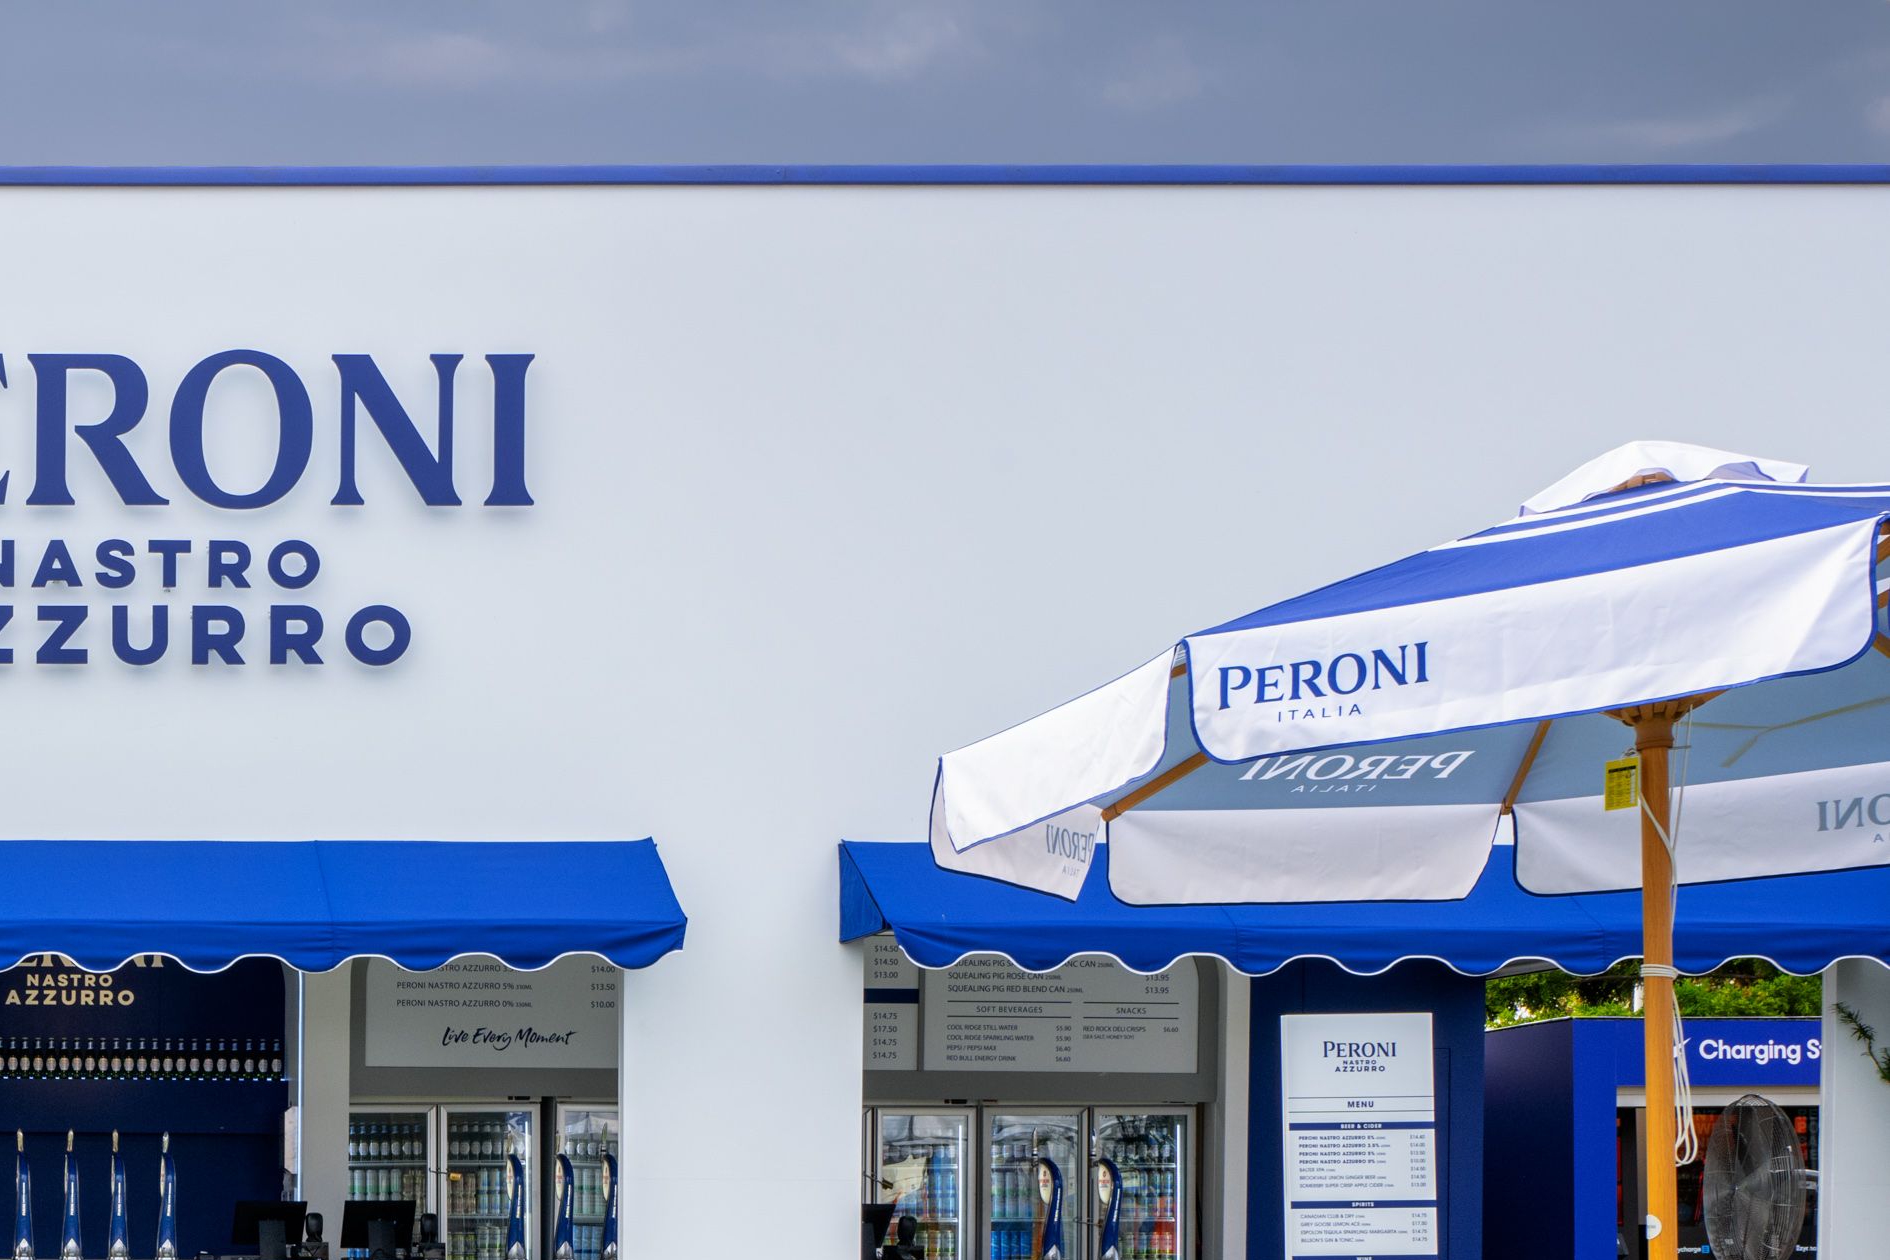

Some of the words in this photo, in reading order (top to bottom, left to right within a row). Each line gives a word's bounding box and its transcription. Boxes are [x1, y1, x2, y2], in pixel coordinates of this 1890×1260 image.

[1218, 641, 1429, 711] PERONI
[1278, 703, 1362, 722] ITALIA
[874, 958, 899, 966] $14.50
[1080, 960, 1096, 968] CAN
[591, 966, 616, 974] $14.00
[948, 972, 991, 980] SQUEALING
[993, 972, 1005, 980] PIG
[1146, 974, 1169, 982] $13.95
[27, 974, 113, 987] NASTRO
[397, 982, 426, 990] PERONI
[428, 982, 460, 990] NASTRO
[462, 982, 501, 990] AZZURRO
[591, 983, 616, 992] $13.50
[948, 985, 990, 993] SQUEALING
[992, 985, 1004, 993] PIG
[1007, 985, 1021, 993] RED
[5, 990, 135, 1006] AZZURRO
[462, 1000, 500, 1008] AZZURRO
[502, 1000, 514, 1008] 0%
[591, 1001, 615, 1009] $10.00
[999, 1006, 1043, 1014] BEVERAGES
[873, 1012, 898, 1020] $14.75
[442, 1027, 469, 1047] Live
[472, 1028, 512, 1051] Every
[515, 1027, 578, 1048] Moment
[873, 1038, 897, 1046] $14.75
[1323, 1041, 1396, 1058] PERONI
[1699, 1039, 1802, 1065] Charging
[1806, 1039, 1822, 1060] S
[872, 1052, 897, 1060] $14.75
